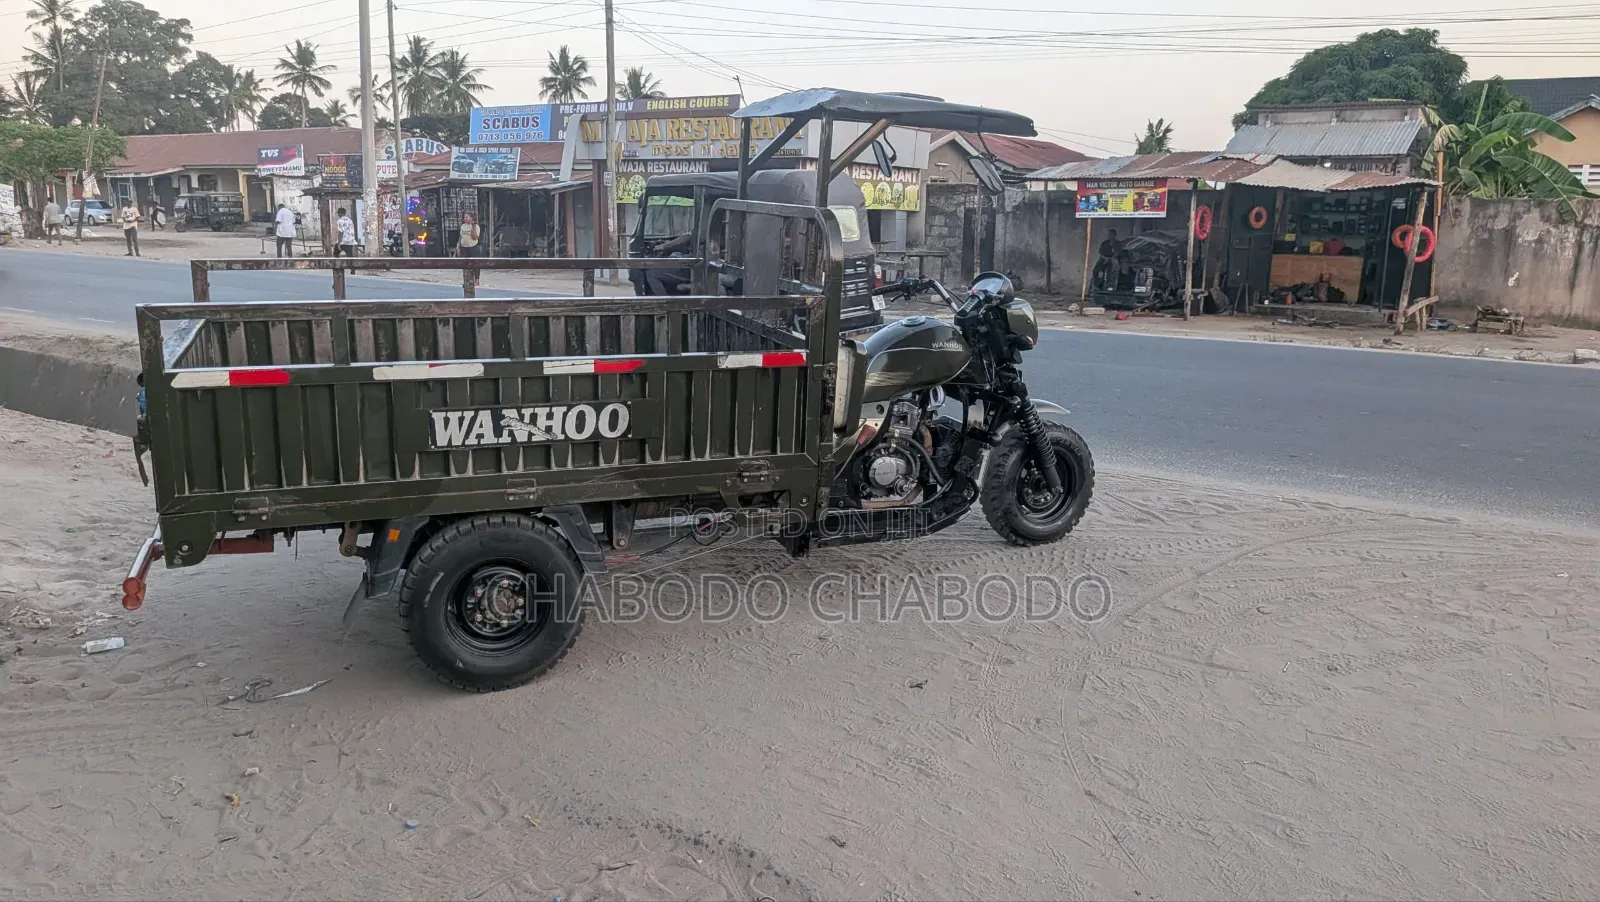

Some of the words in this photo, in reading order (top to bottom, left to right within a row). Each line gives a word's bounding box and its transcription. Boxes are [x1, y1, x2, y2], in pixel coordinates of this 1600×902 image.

[560, 103, 598, 114] PRE-FORM
[647, 98, 687, 110] ENGLISH
[690, 97, 729, 108] COURSE
[482, 116, 541, 130] SCABUS
[666, 117, 804, 141] RESTAURAN
[478, 133, 500, 141] 0713
[503, 132, 522, 140] 056
[525, 132, 543, 140] 976
[260, 149, 279, 158] TVS
[385, 138, 445, 160] SABUS
[718, 138, 759, 158] daa
[647, 161, 709, 173] RESTAURANT
[852, 164, 918, 183] RESTARANT
[931, 341, 963, 349] WANHOO
[431, 402, 631, 447] WANHOO
